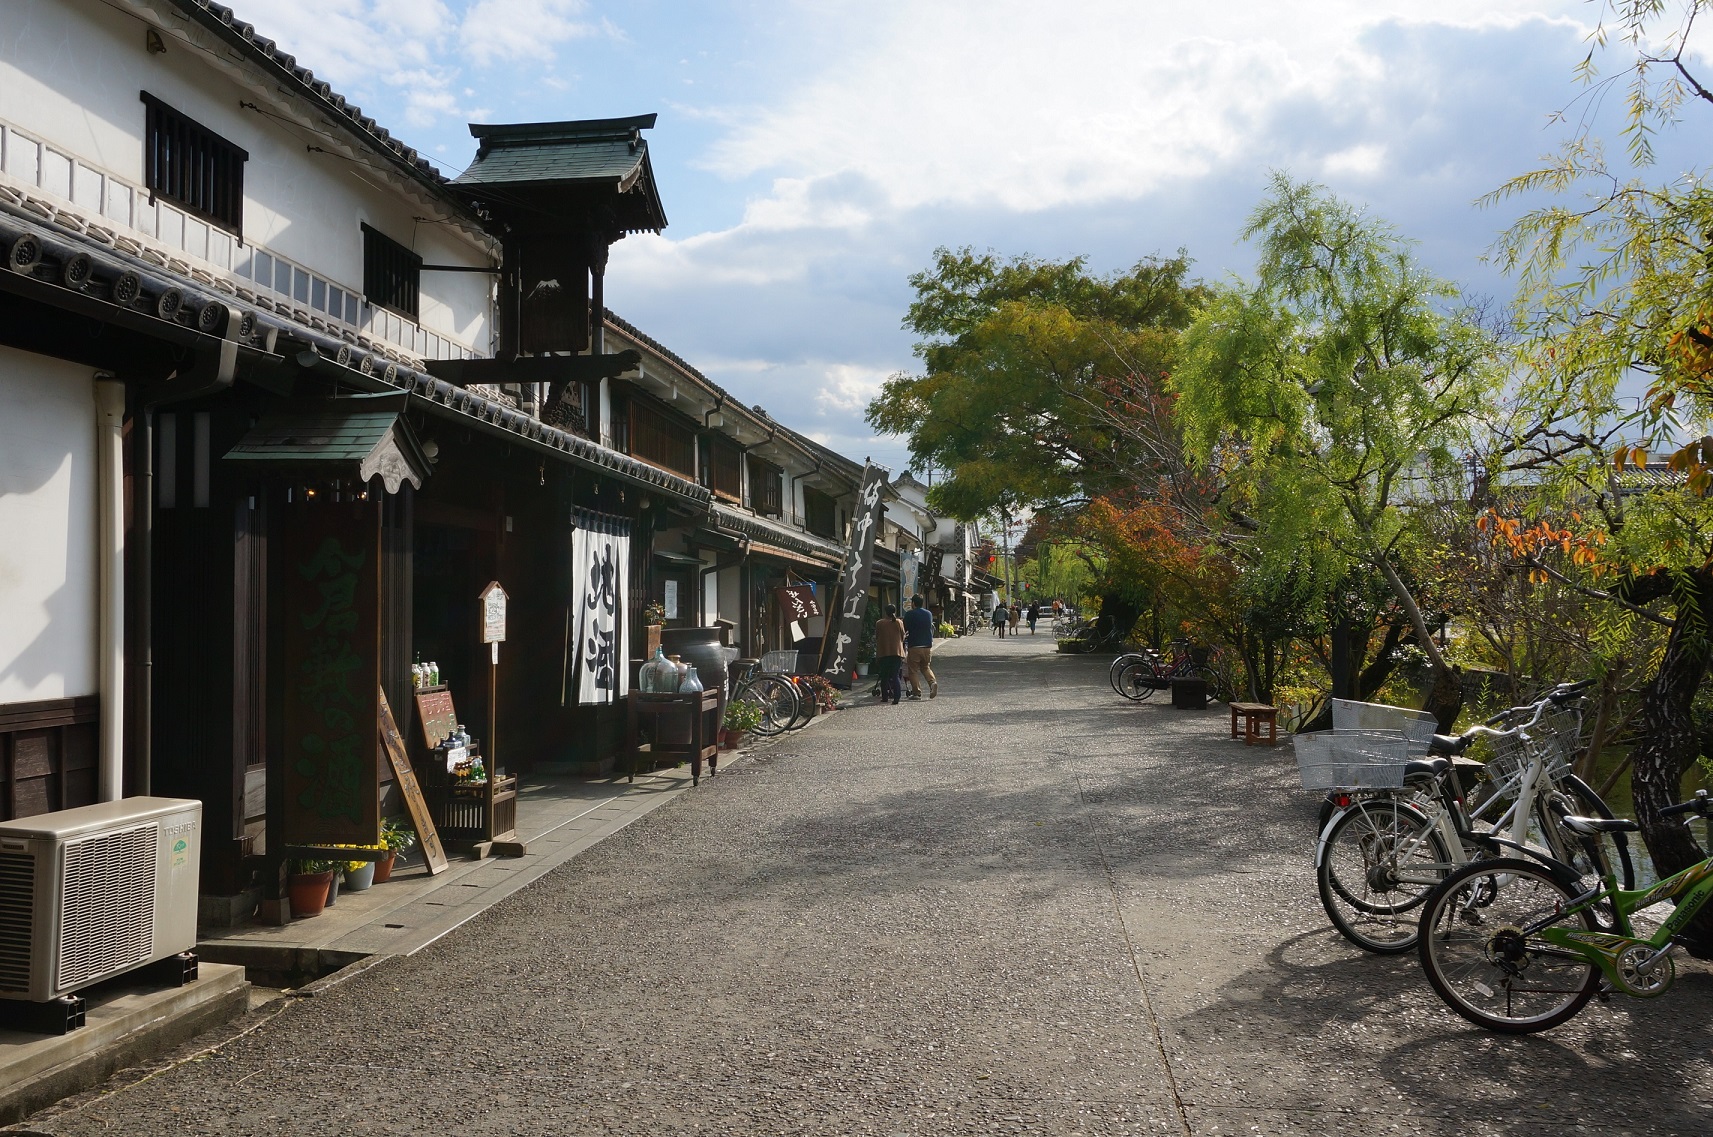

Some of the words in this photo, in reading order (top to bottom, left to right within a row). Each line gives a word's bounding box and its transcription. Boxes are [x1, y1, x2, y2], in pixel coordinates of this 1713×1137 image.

[586, 543, 614, 691] 地酒
[298, 535, 366, 825] 倉敷の酒
[164, 821, 196, 837] TOSHIBA
[1666, 890, 1705, 931] Panasonic
